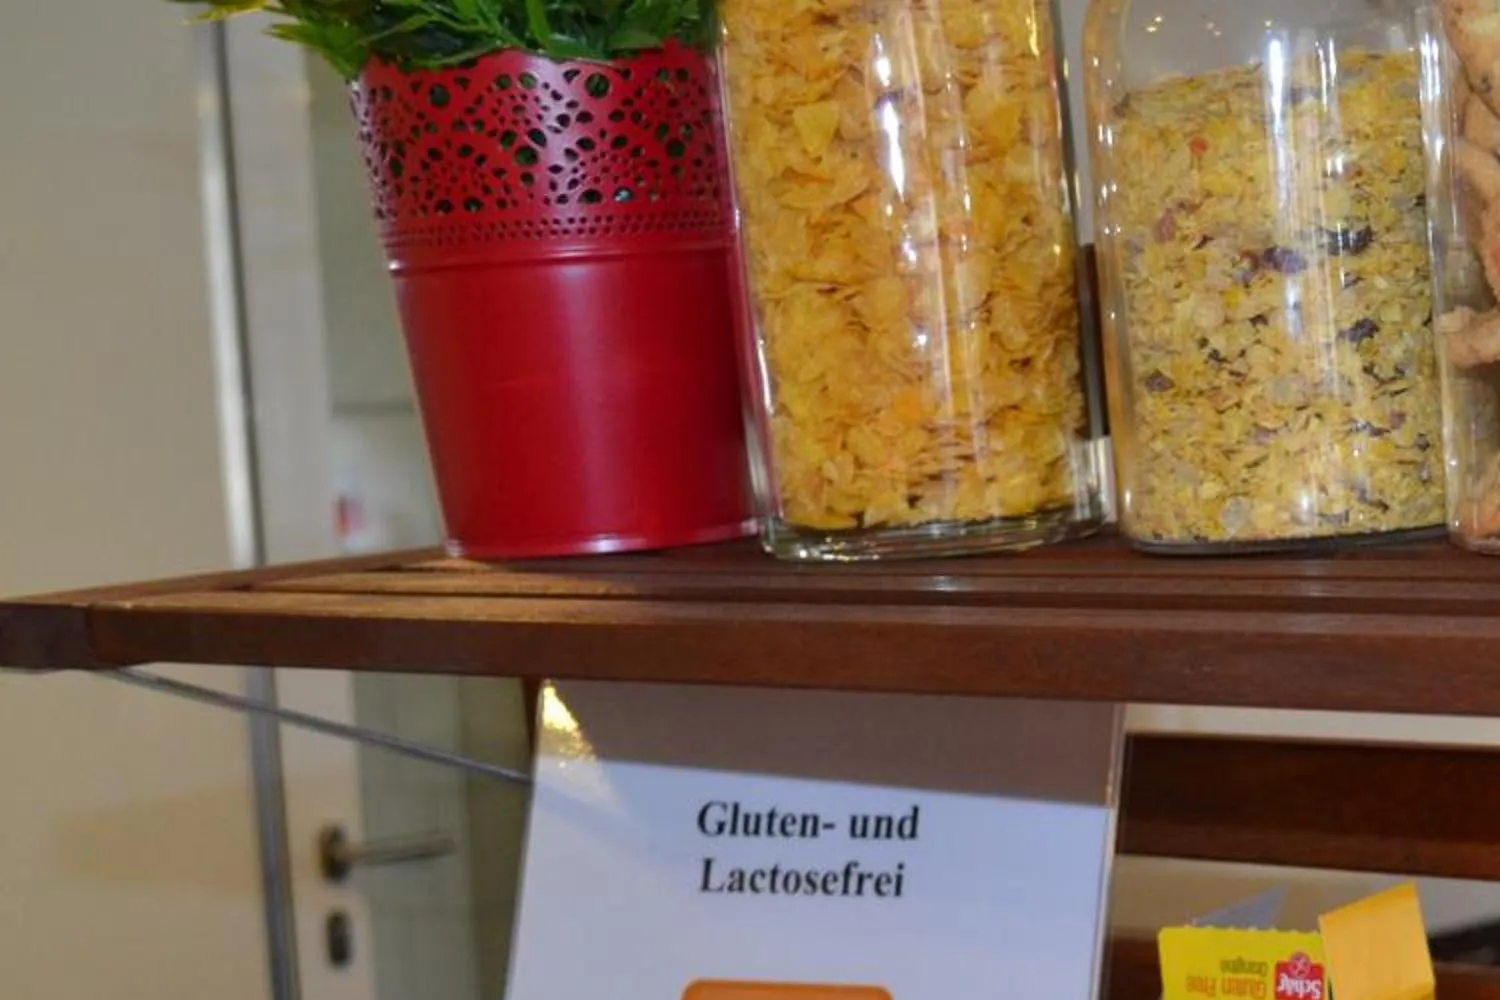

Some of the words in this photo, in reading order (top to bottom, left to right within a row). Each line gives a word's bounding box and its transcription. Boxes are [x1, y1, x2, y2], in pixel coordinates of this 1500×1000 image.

[697, 800, 836, 838] Gluten-
[849, 804, 920, 841] und
[699, 856, 905, 898] Lactosefrei
[1277, 973, 1323, 1000] Schär
